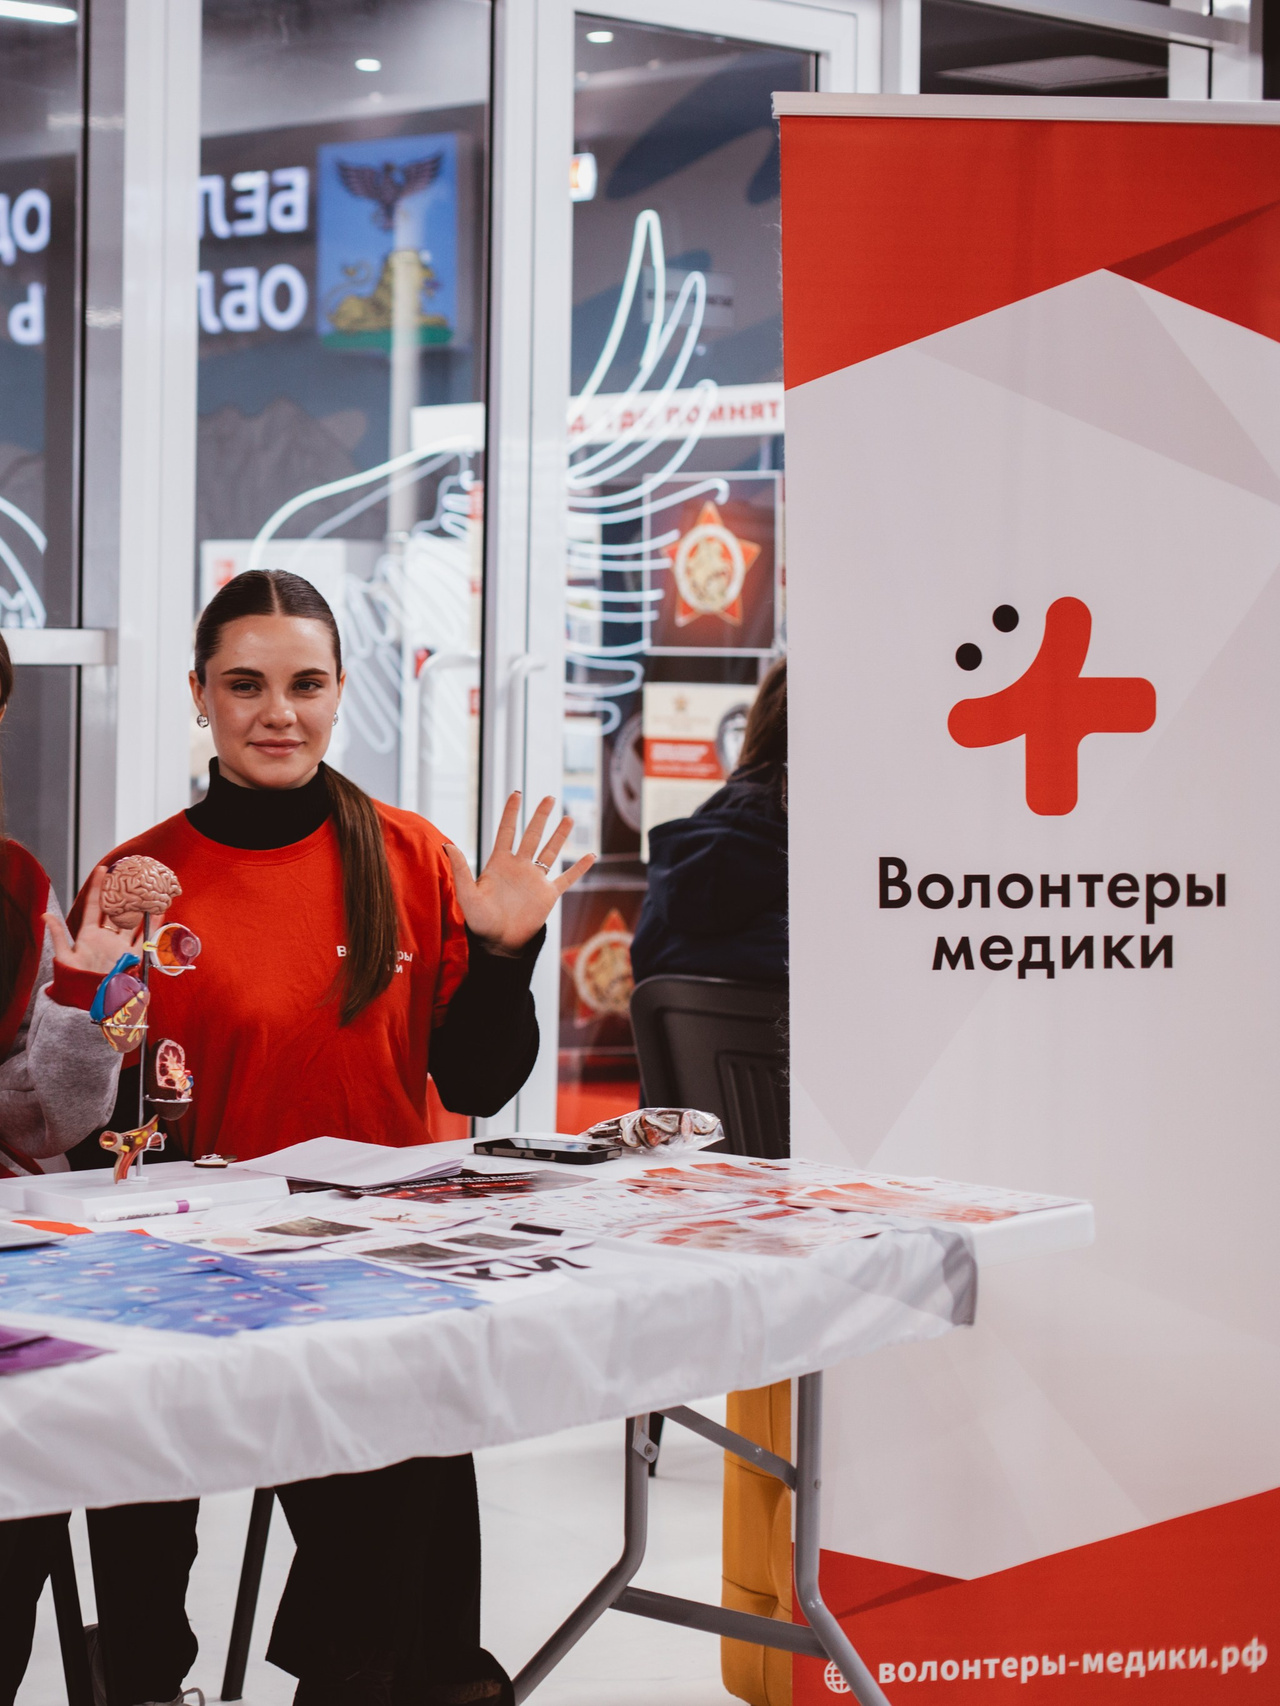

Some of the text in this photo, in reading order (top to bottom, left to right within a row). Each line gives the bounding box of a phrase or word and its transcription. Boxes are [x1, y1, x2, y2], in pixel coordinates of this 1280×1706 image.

[878, 856, 1226, 925] Волонтеры
[931, 934, 1174, 979] медики
[878, 1635, 1268, 1684] волонтеры-медики.рф
